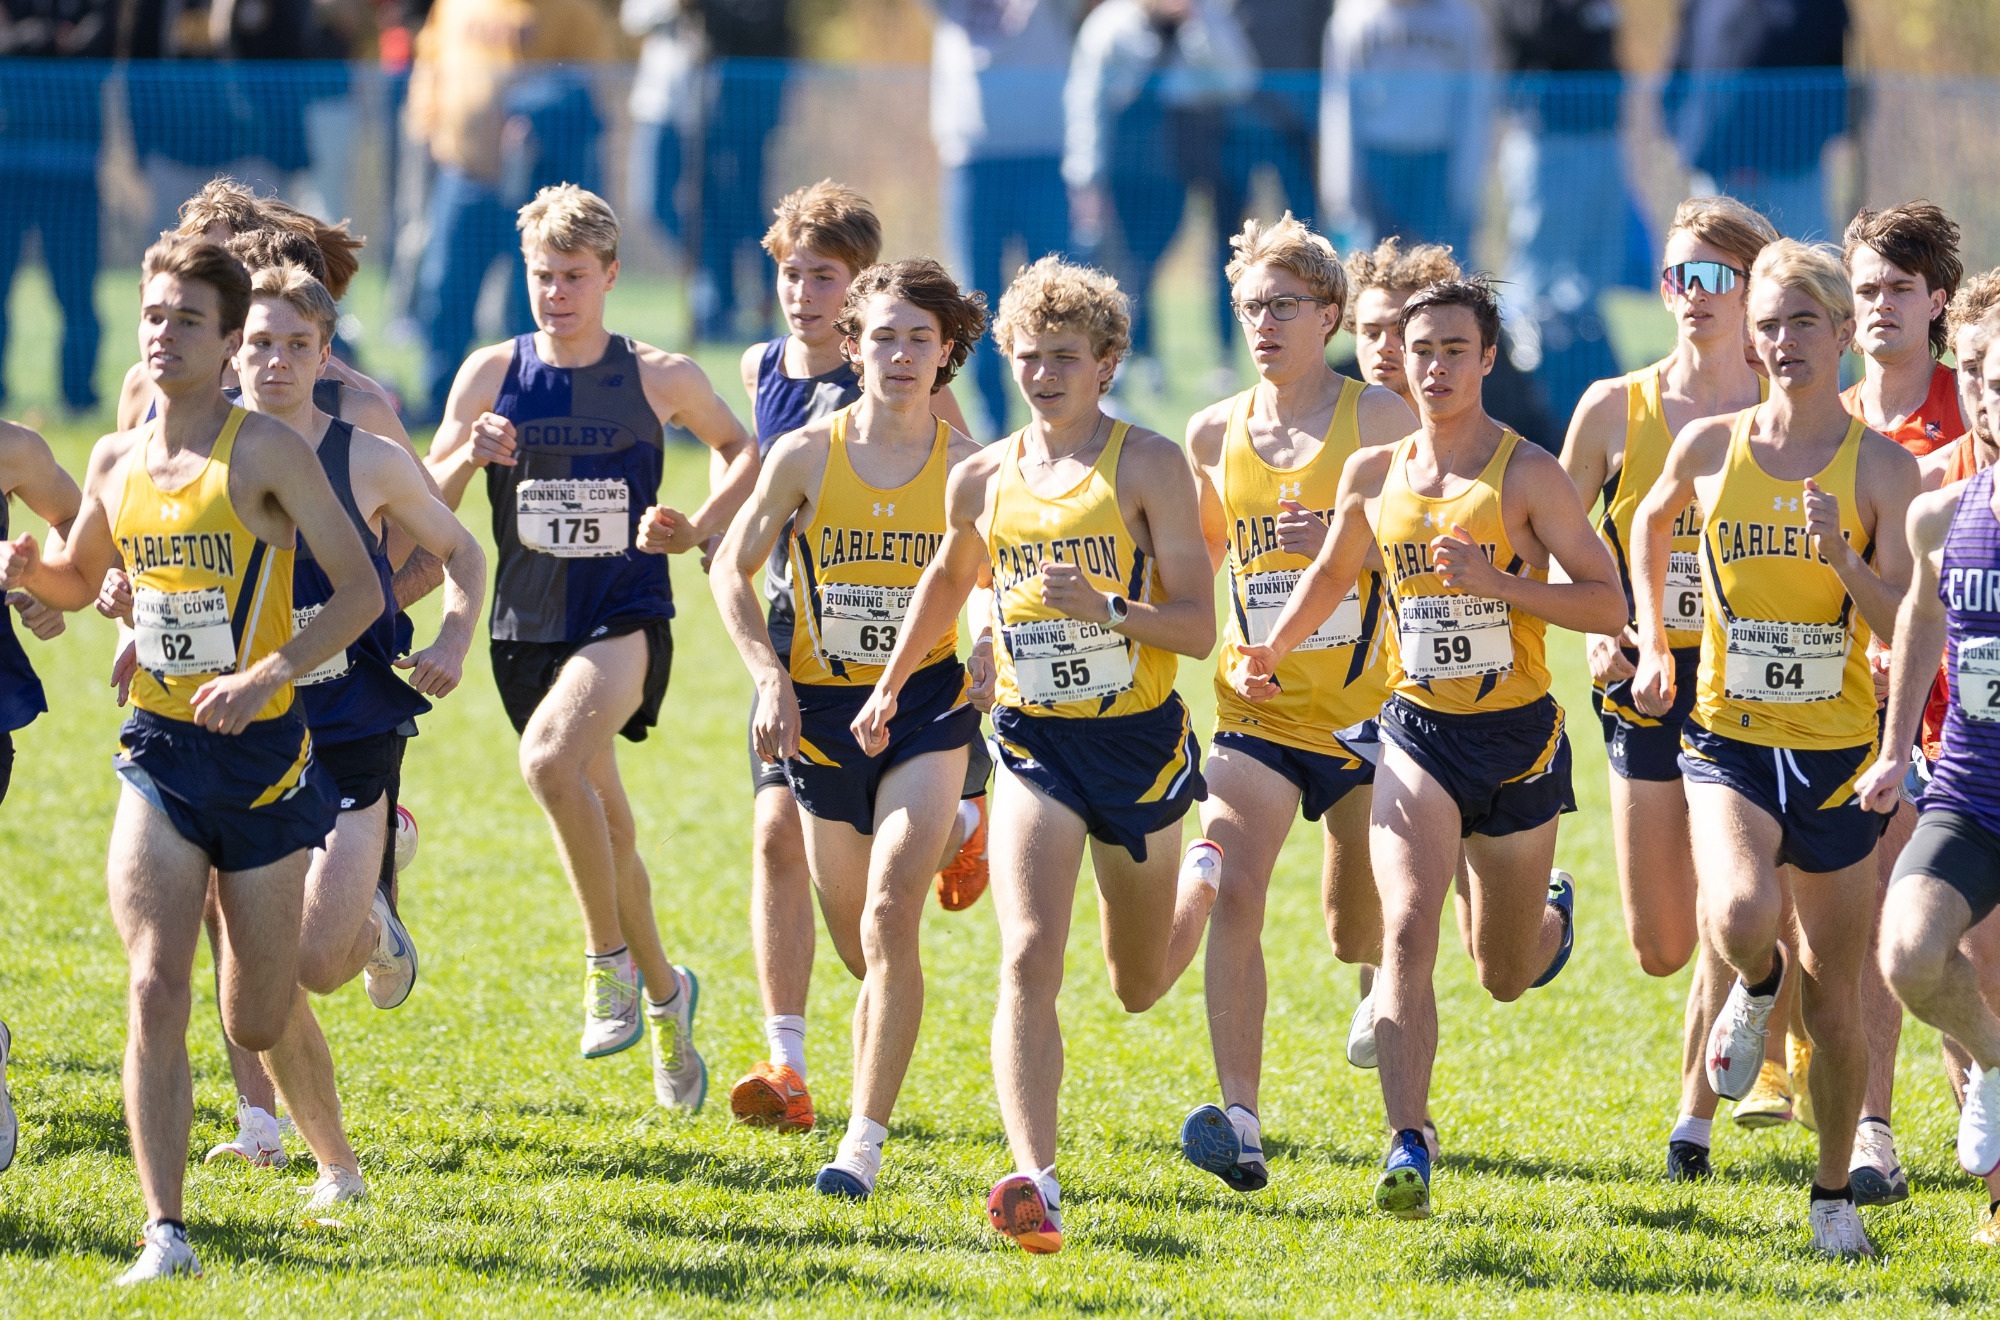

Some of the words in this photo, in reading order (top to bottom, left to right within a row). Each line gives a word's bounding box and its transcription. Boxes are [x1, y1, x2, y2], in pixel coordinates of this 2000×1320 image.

[524, 426, 619, 448] COLBY
[522, 489, 575, 500] RUNNING
[589, 488, 626, 500] COWS
[547, 518, 600, 544] 175
[1718, 520, 1850, 565] CARLET
[1667, 562, 1700, 574] NING
[826, 592, 882, 608] RUNNING
[848, 588, 884, 596] CARLETON
[184, 598, 224, 614] COWS
[1403, 606, 1450, 620] RUNNING
[1464, 600, 1504, 616] COWS
[1015, 630, 1066, 646] RUNNING
[1080, 625, 1110, 638] COW
[1032, 624, 1064, 632] CARLETON
[1752, 624, 1789, 632] CARLETON
[860, 625, 897, 652] 63
[1731, 628, 1788, 644] RUNNING
[1803, 632, 1842, 645] COWS
[162, 634, 194, 660] 62
[842, 650, 879, 658] PRE-NATIONAL
[1434, 636, 1472, 664] 59
[1051, 658, 1091, 688] 55
[1456, 662, 1496, 670] CHAMPIONSHIP
[1765, 662, 1804, 689] 64
[1077, 682, 1116, 692] CHAMPIONSHIP
[1741, 714, 1750, 728] 8
